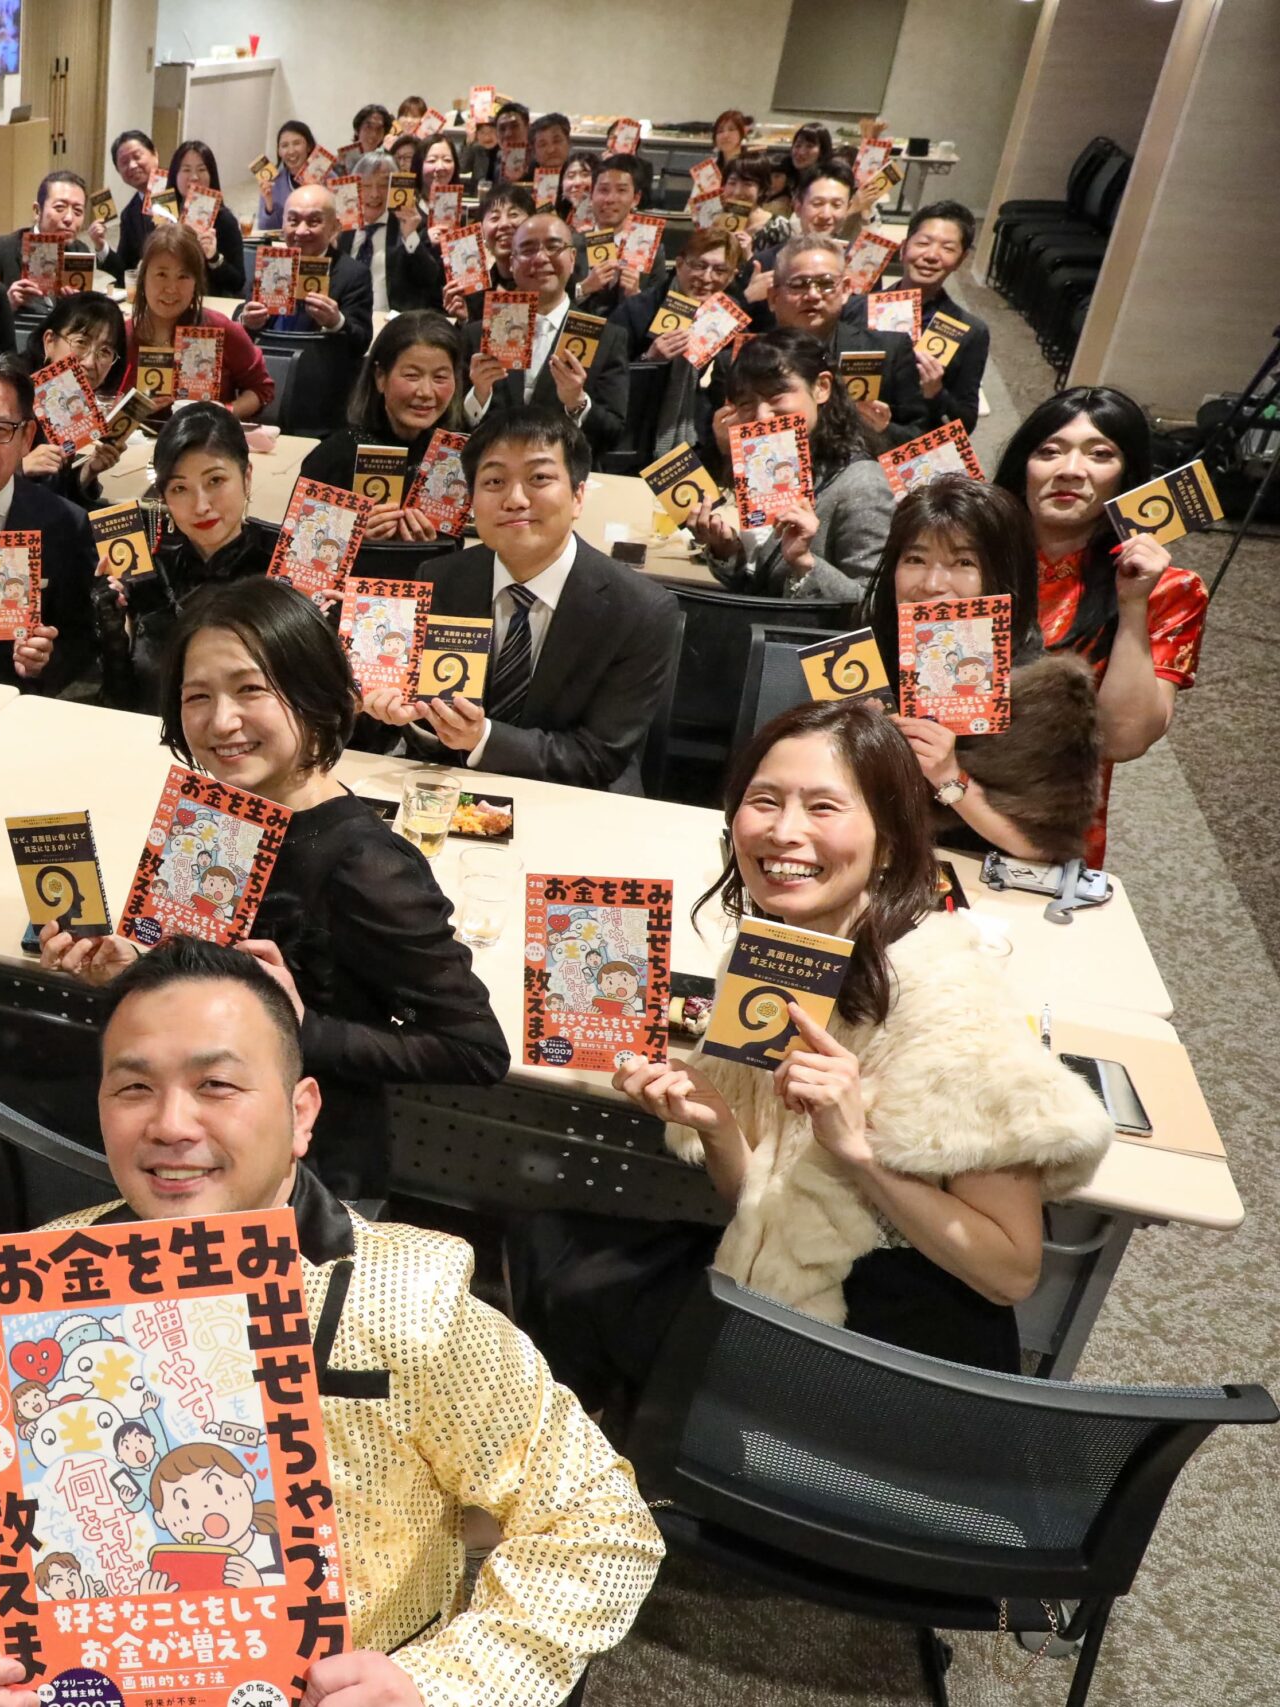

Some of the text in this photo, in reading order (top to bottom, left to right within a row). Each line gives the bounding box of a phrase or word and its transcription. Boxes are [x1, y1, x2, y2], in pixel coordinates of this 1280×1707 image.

[180, 773, 288, 830] お金を生み
[227, 829, 283, 949] 出せちゃう方
[544, 877, 673, 906] お金を生み
[749, 957, 824, 981] 貧乏になるのか?
[523, 965, 553, 1066] 教えます
[550, 1012, 641, 1030] 好きなことをして
[558, 1025, 635, 1043] お金が増える
[318, 1524, 341, 1601] 中城裕貴
[53, 1595, 277, 1634] 好きなことをして
[80, 1628, 268, 1669] お金が増える
[53, 1678, 110, 1688] サラリーマンも
[61, 1688, 104, 1698] 専業主婦も
[122, 1671, 226, 1690] 画期的な方法
